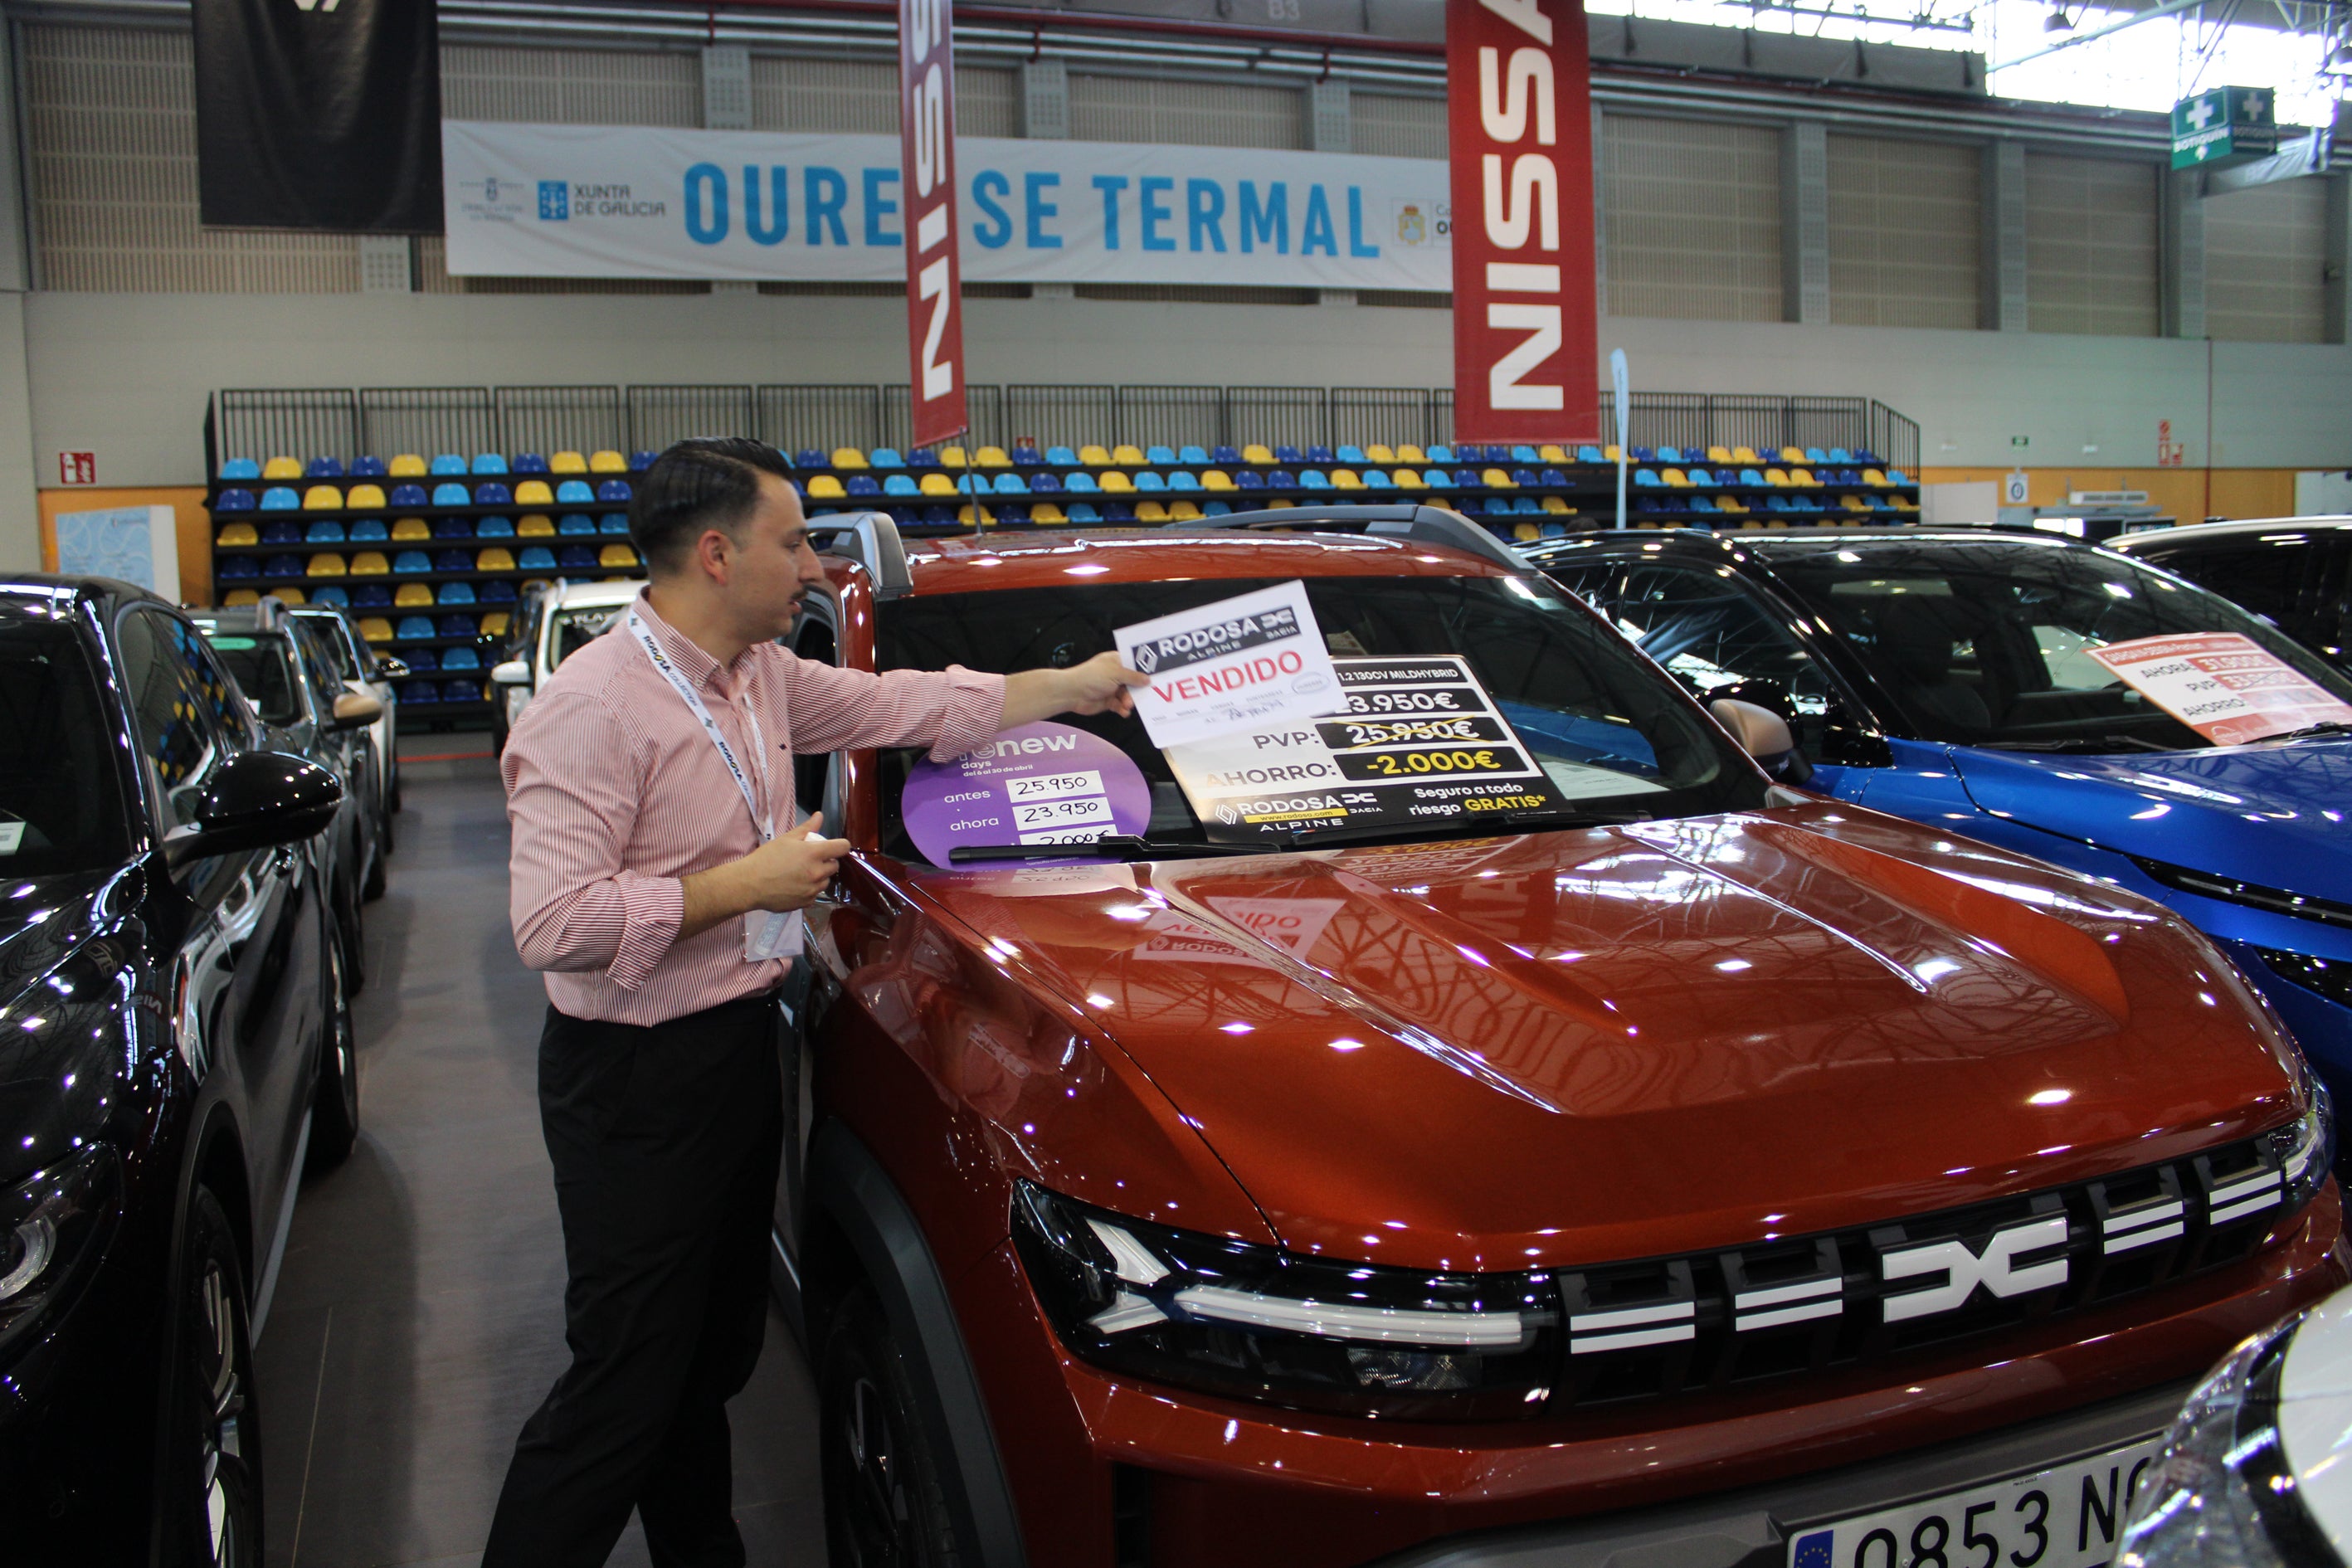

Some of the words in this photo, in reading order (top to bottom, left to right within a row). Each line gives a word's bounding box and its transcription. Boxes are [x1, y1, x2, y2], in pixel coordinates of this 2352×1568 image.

[574, 184, 631, 199] XUNTA
[574, 202, 596, 215] DE
[598, 202, 666, 216] GALICIA
[684, 162, 1063, 250] OURESE
[1093, 175, 1380, 258] TERMAL
[1157, 617, 1261, 657] RODOSA
[1187, 640, 1242, 661] ALPINE
[1152, 650, 1303, 704] VENDIDO
[1354, 670, 1389, 680] 130CV
[1390, 669, 1459, 679] MILDHYBRID
[1335, 692, 1460, 713] 3.950€
[1252, 731, 1320, 749] PVP:
[1346, 721, 1480, 743] 25.950€
[959, 734, 1077, 761] enew
[961, 760, 992, 769] days
[1206, 763, 1337, 787] AHORRO:
[1366, 750, 1502, 775] -2.000€
[1015, 777, 1087, 796] 25.950
[1414, 787, 1472, 800] Seguro
[1473, 786, 1483, 795] a
[1486, 782, 1524, 794] todo
[944, 790, 991, 803] antes
[1236, 796, 1343, 816] RODOSA
[1024, 802, 1098, 822] 23.950
[1260, 811, 1333, 822] www.rodosa.com
[1350, 806, 1384, 815] DACIA
[1409, 801, 1462, 816] riesgo
[950, 816, 999, 831] ahora
[1260, 818, 1345, 832] ALPINE
[2078, 1457, 2151, 1553] N
